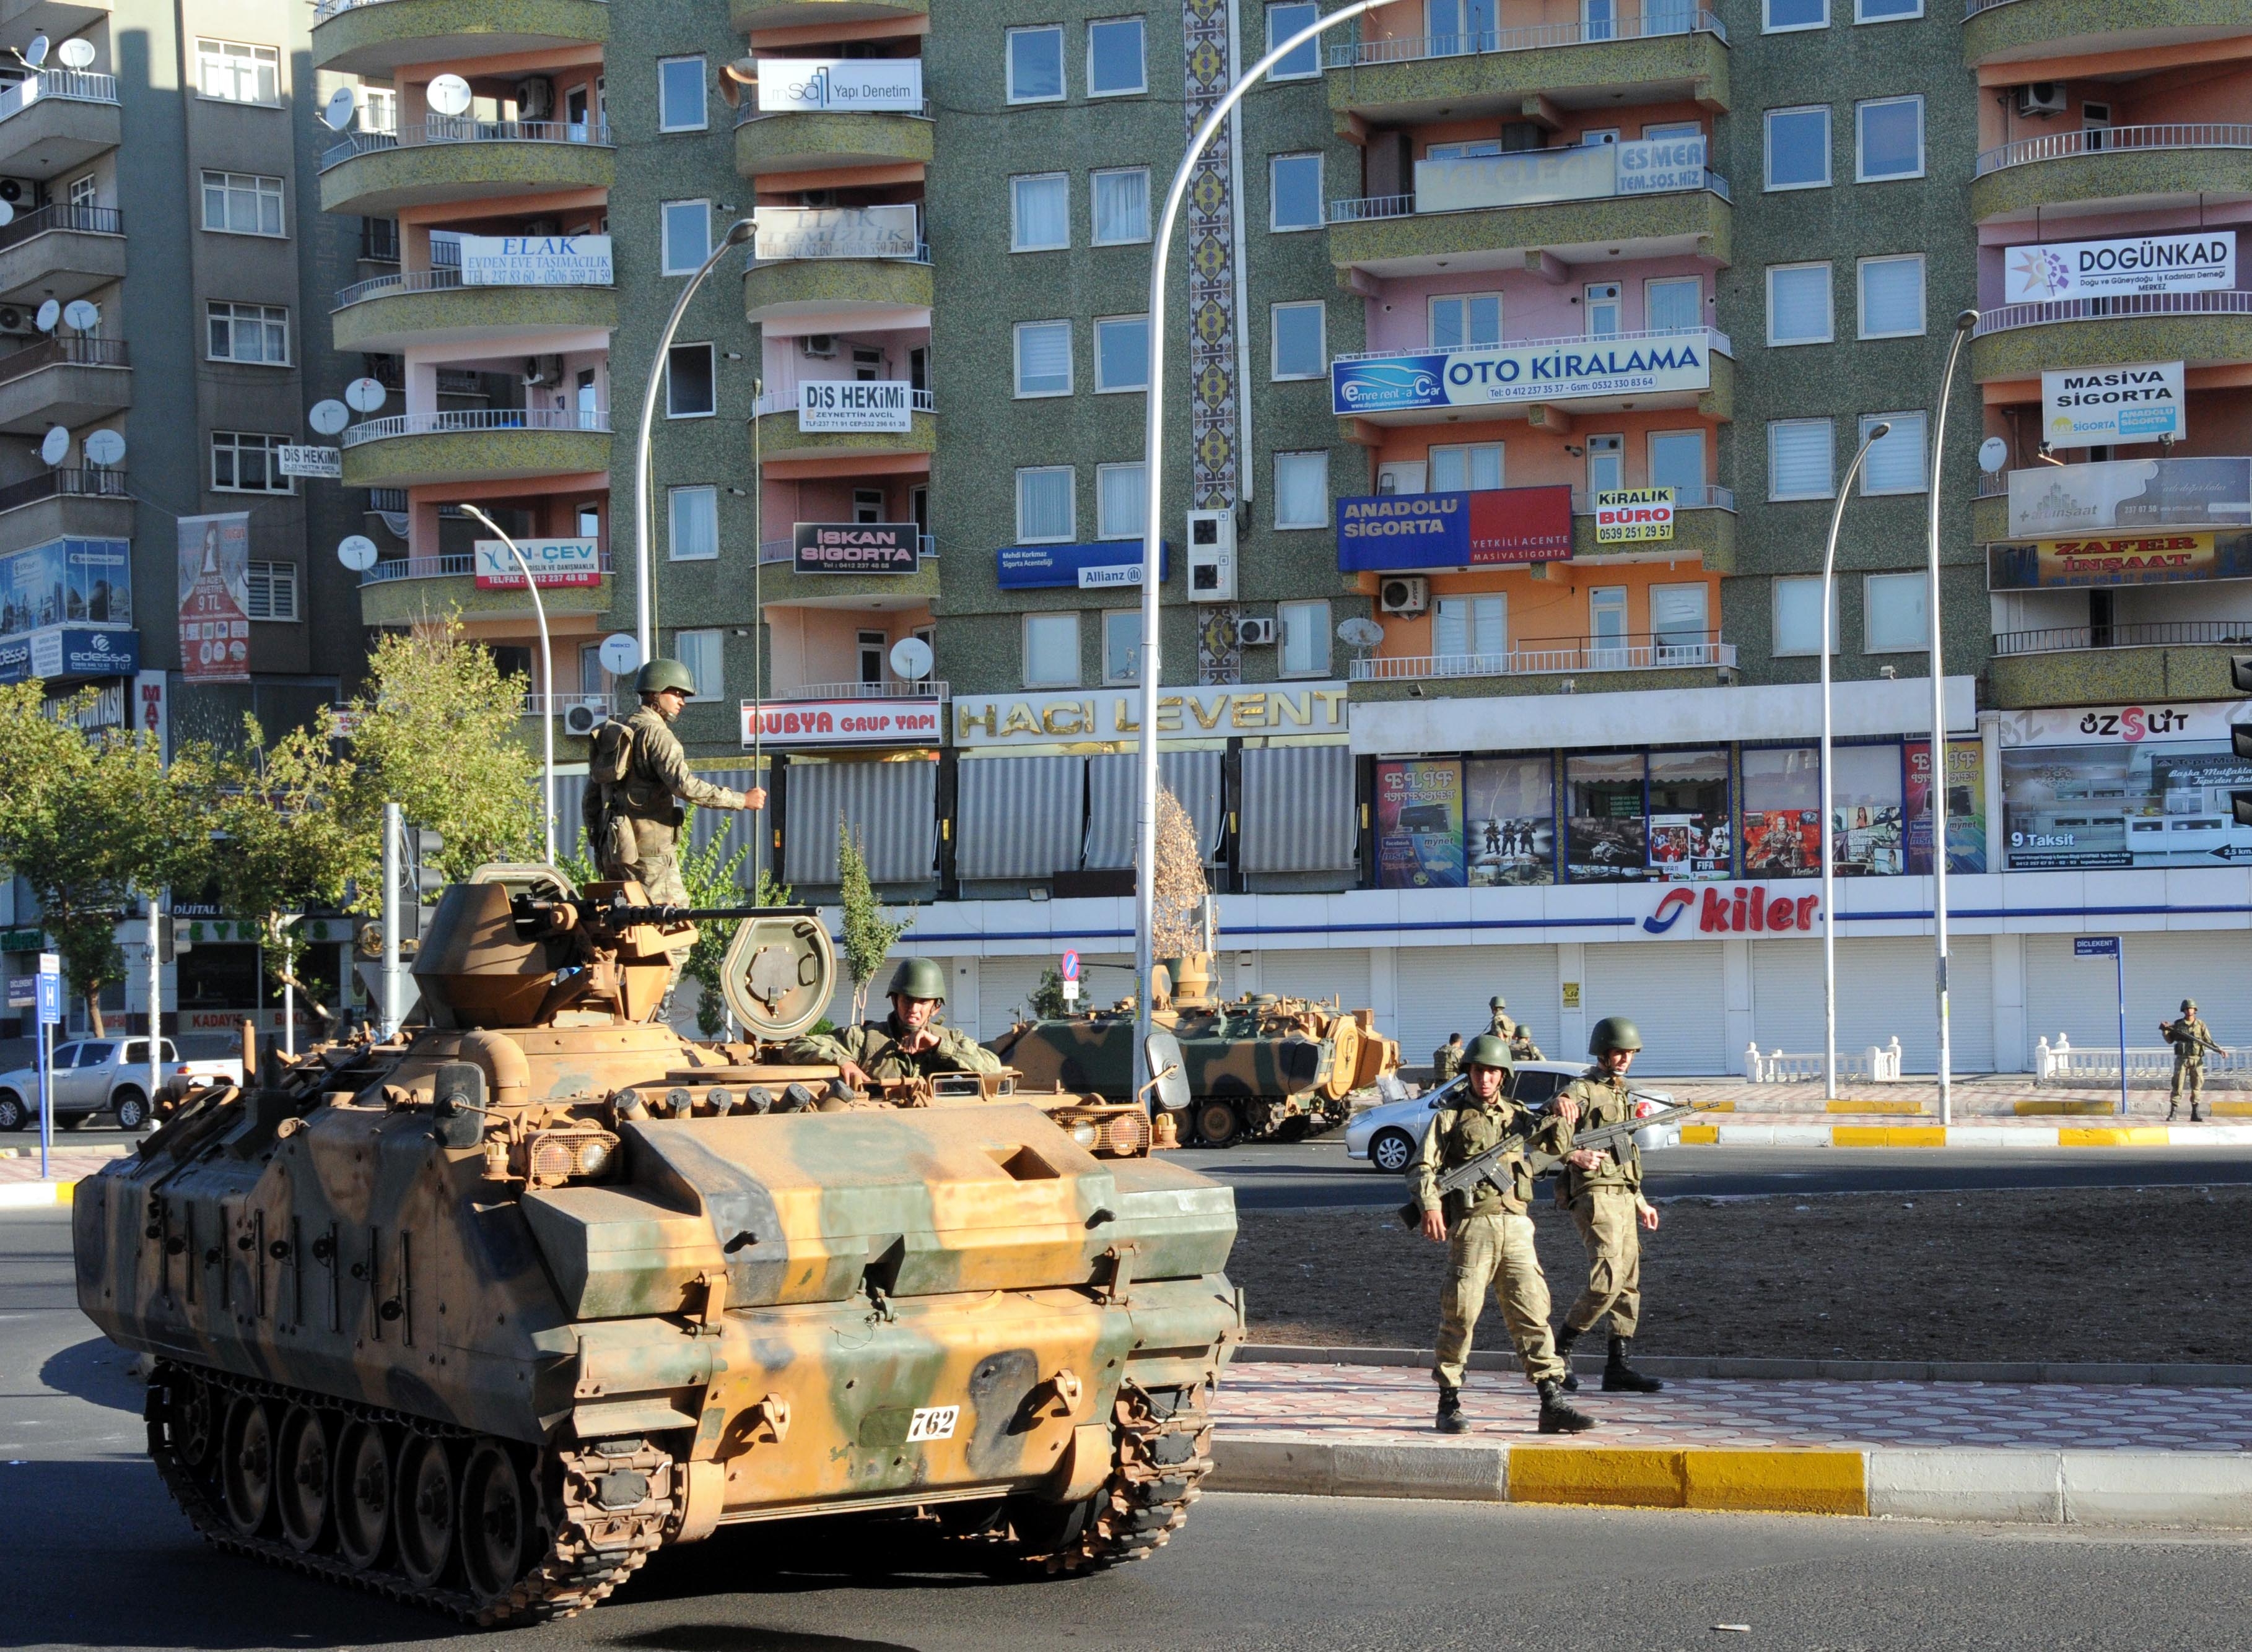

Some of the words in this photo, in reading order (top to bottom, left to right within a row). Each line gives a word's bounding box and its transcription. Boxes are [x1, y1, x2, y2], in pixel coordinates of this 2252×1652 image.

[834, 85, 858, 100] Yapı
[863, 84, 910, 97] Denetim
[1622, 143, 1702, 170] ESMER
[798, 209, 878, 228] ELAK
[502, 237, 578, 255] ELAK
[889, 241, 898, 254] 71
[901, 241, 913, 253] 59
[468, 257, 507, 268] EVDEN
[511, 257, 532, 267] EVE
[536, 256, 608, 271] TAŞIMACILIK
[2079, 240, 2228, 272] DOGÜNKAD
[468, 270, 488, 284] TEL:
[492, 270, 507, 284] 237
[523, 270, 535, 284] 60
[570, 269, 586, 283] 559
[588, 269, 597, 283] 71
[600, 269, 611, 283] 59
[2080, 279, 2100, 287] Doğu
[2111, 275, 2154, 287] Güneydoğu
[2164, 272, 2196, 282] Kadınları
[2197, 269, 2225, 279] Derneği
[2138, 283, 2167, 292] MERKEZ
[1449, 359, 1520, 386] OTO
[1532, 345, 1700, 380] KİRALAMA
[2064, 370, 2165, 389] MASİVA
[1380, 388, 1399, 399] rent
[1415, 377, 1441, 396] Car
[1490, 389, 1503, 398] Tel:
[1512, 387, 1525, 395] 412
[1527, 386, 1541, 394] 237
[1543, 385, 1553, 393] 35
[1555, 385, 1564, 393] 37
[1571, 383, 1591, 392] Gsm:
[1592, 381, 1612, 390] 0532
[1614, 380, 1629, 388] 330
[1631, 379, 1641, 387] 83
[1643, 378, 1653, 386] 64
[2056, 388, 2173, 407] SİGORTA
[2120, 407, 2174, 419] ANADOLU
[2120, 416, 2168, 426] SİGORTA
[2073, 420, 2116, 432] SİGORTA
[1344, 498, 1457, 518] ANADOLU
[1599, 507, 1670, 525] BÜRO
[2124, 506, 2136, 514] 237
[1344, 519, 1445, 537] SİGORTA
[1599, 527, 1622, 541] 0539
[1625, 526, 1641, 539] 251
[1645, 526, 1657, 537] 29
[1659, 524, 1671, 537] 57
[816, 528, 896, 545] İSKAN
[1472, 536, 1517, 549] YETKİLİ
[1522, 535, 1568, 546] ACENTE
[801, 545, 912, 561] SİGORTA
[1002, 551, 1021, 559] Mehdi
[1022, 550, 1047, 559] Korkmaz
[2054, 537, 2198, 556] ZAFER
[1473, 551, 1515, 561] MASİVA
[1519, 549, 1566, 559] SİGORTA
[508, 564, 548, 572] MÜHDİSLİK
[557, 563, 595, 572] DANIŞMANLIK
[1002, 560, 1023, 569] Sigorta
[1024, 559, 1053, 568] Acenteliği
[2064, 554, 2193, 573] İNŞAAT
[489, 576, 520, 584] TEL/FAX
[1085, 571, 1125, 583] Allianz
[198, 595, 205, 611] 9
[208, 594, 222, 611] TL
[70, 651, 132, 662] edessa
[958, 699, 1095, 738] HACI
[1114, 690, 1348, 731] LEVENT
[748, 711, 833, 735] BUBYA
[840, 715, 890, 733] GRUP
[895, 714, 935, 730] YAPI
[1384, 765, 1454, 789] ELİF
[2168, 769, 2200, 778] Başka
[2192, 776, 2231, 786] Tepe'den
[1949, 820, 1977, 830] mynet
[1424, 837, 1454, 846] mynet
[2011, 832, 2023, 847] 9
[2026, 833, 2075, 847] Taksit
[1697, 861, 1714, 870] FIFA
[173, 902, 217, 915] DİJİTAL
[1700, 885, 1820, 933] kiler
[46, 986, 55, 1007] H
[912, 1410, 954, 1437] 762
